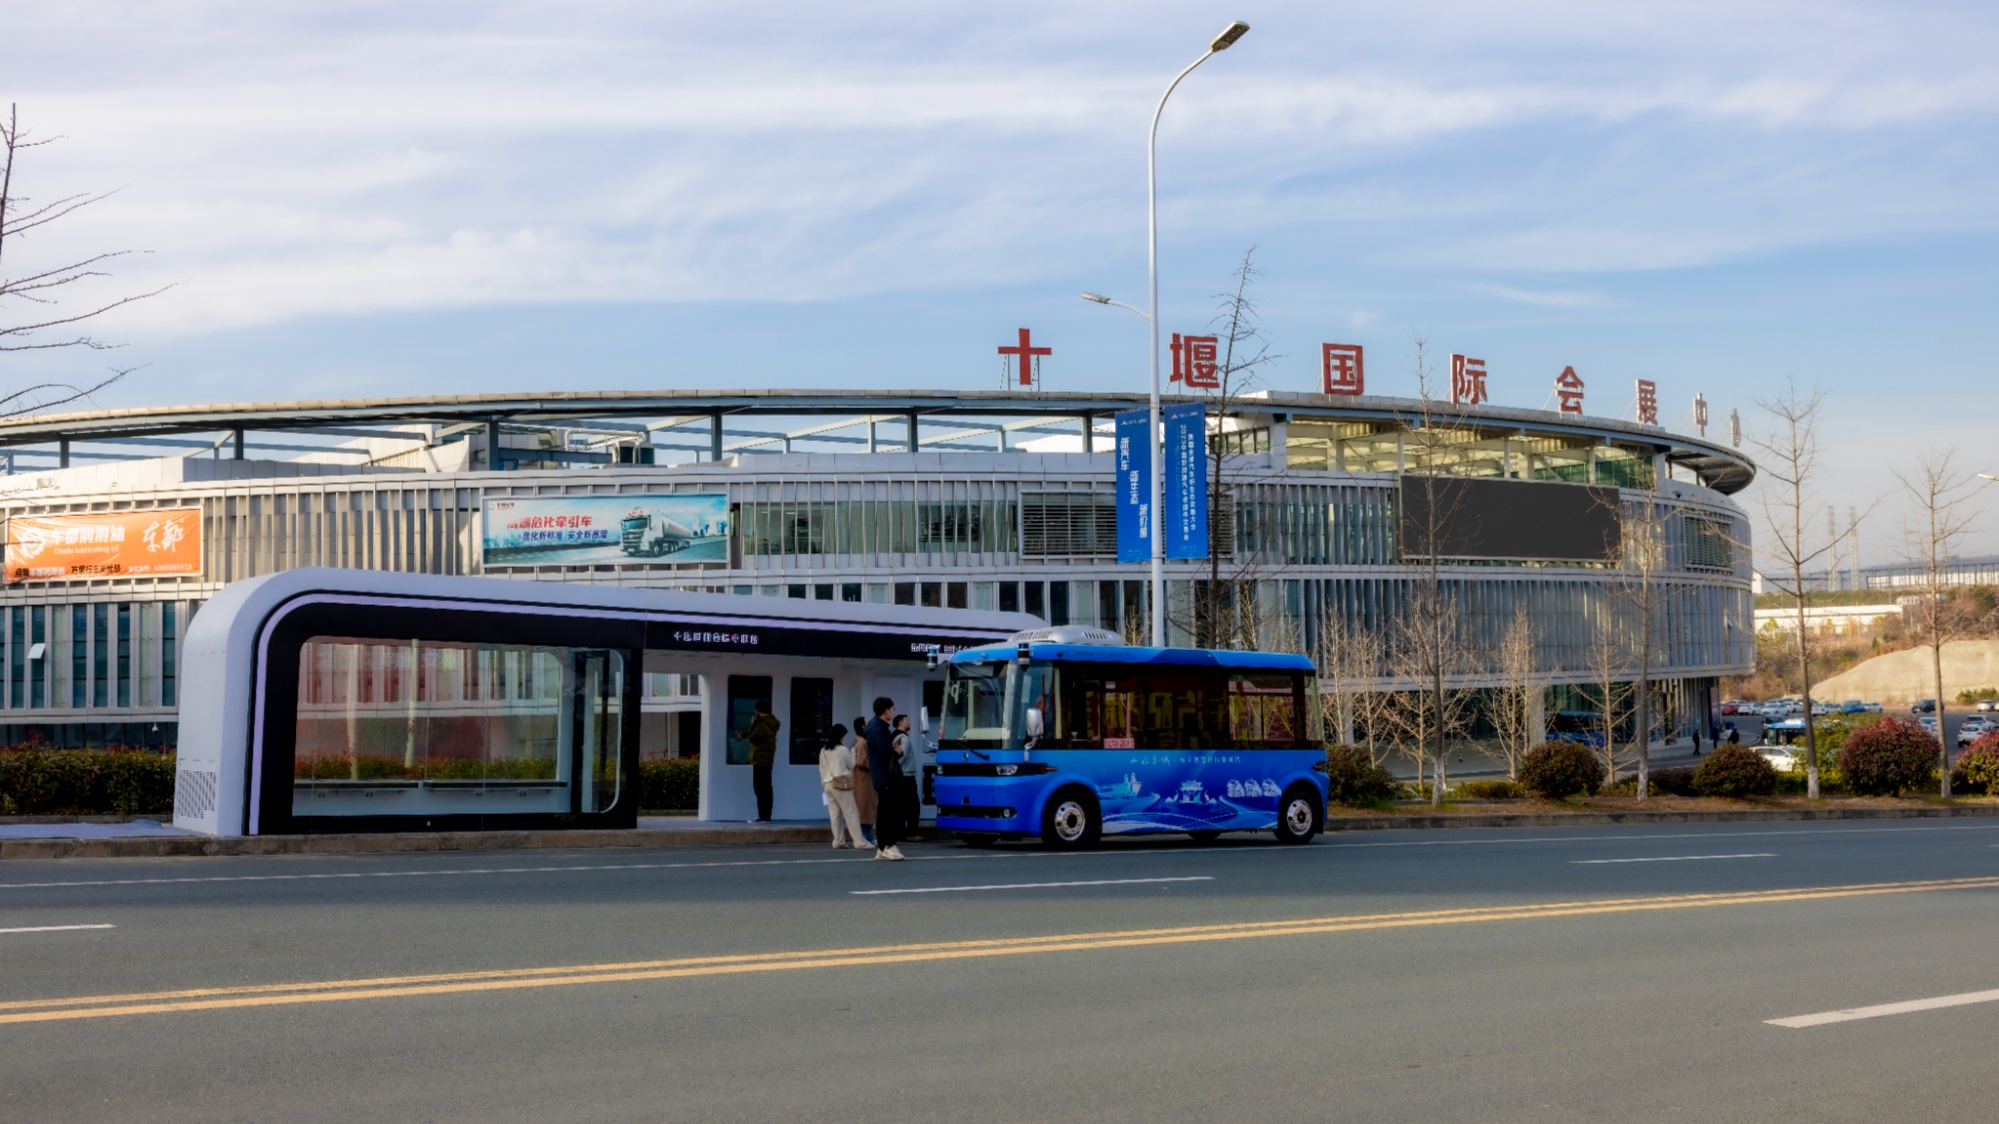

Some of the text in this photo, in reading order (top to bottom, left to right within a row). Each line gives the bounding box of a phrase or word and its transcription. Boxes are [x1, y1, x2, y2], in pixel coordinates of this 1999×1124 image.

[51, 524, 125, 545] 车都润滑油
[74, 546, 110, 554] lubricating
